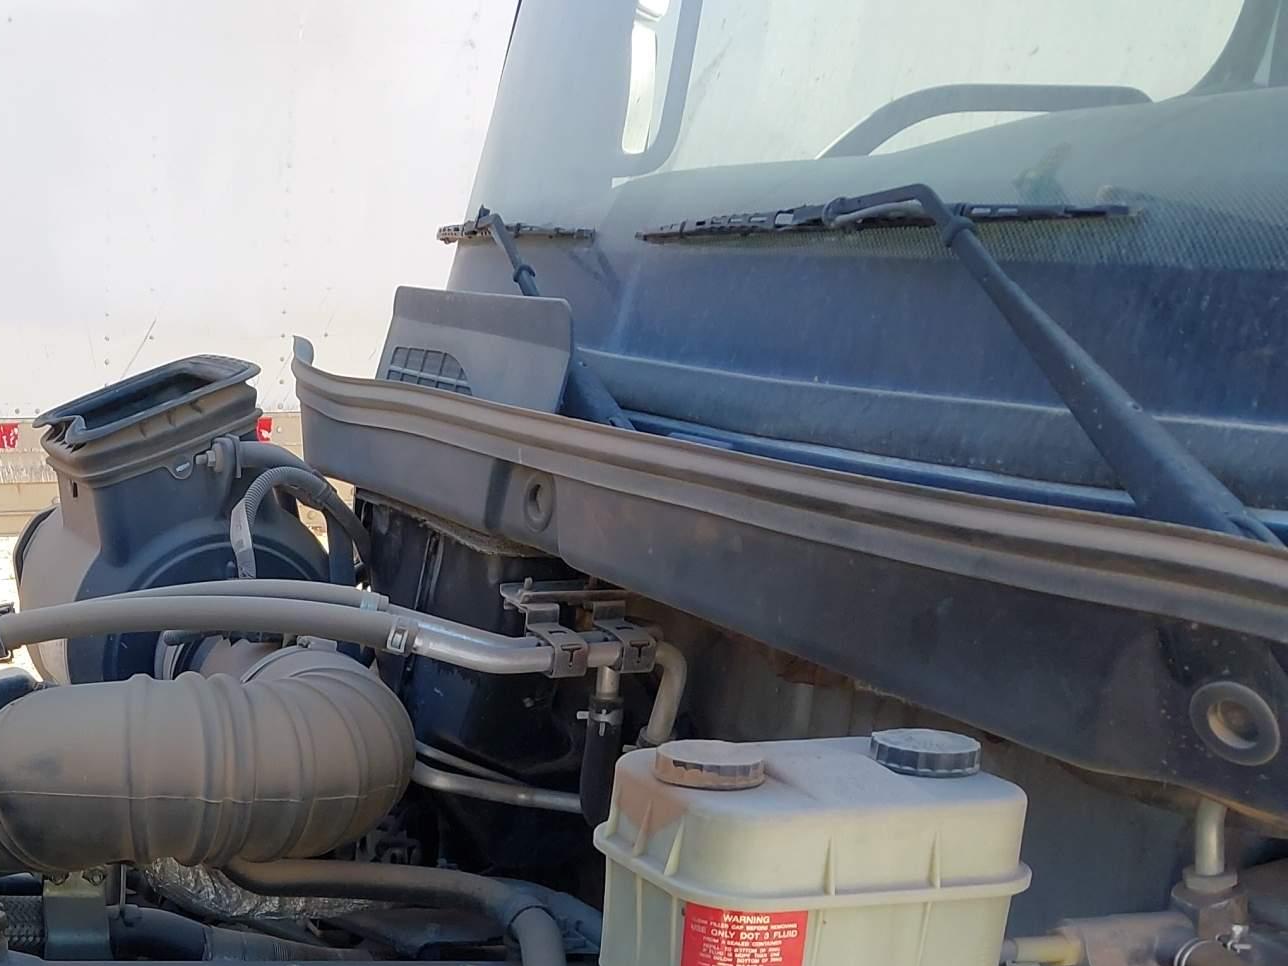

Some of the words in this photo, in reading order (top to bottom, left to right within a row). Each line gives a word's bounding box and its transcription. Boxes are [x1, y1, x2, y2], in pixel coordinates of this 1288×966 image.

[723, 914, 770, 924] WARNING
[711, 928, 736, 939] ONLY
[740, 931, 760, 941] DOT
[763, 932, 770, 940] 3
[773, 929, 798, 939] FLUID
